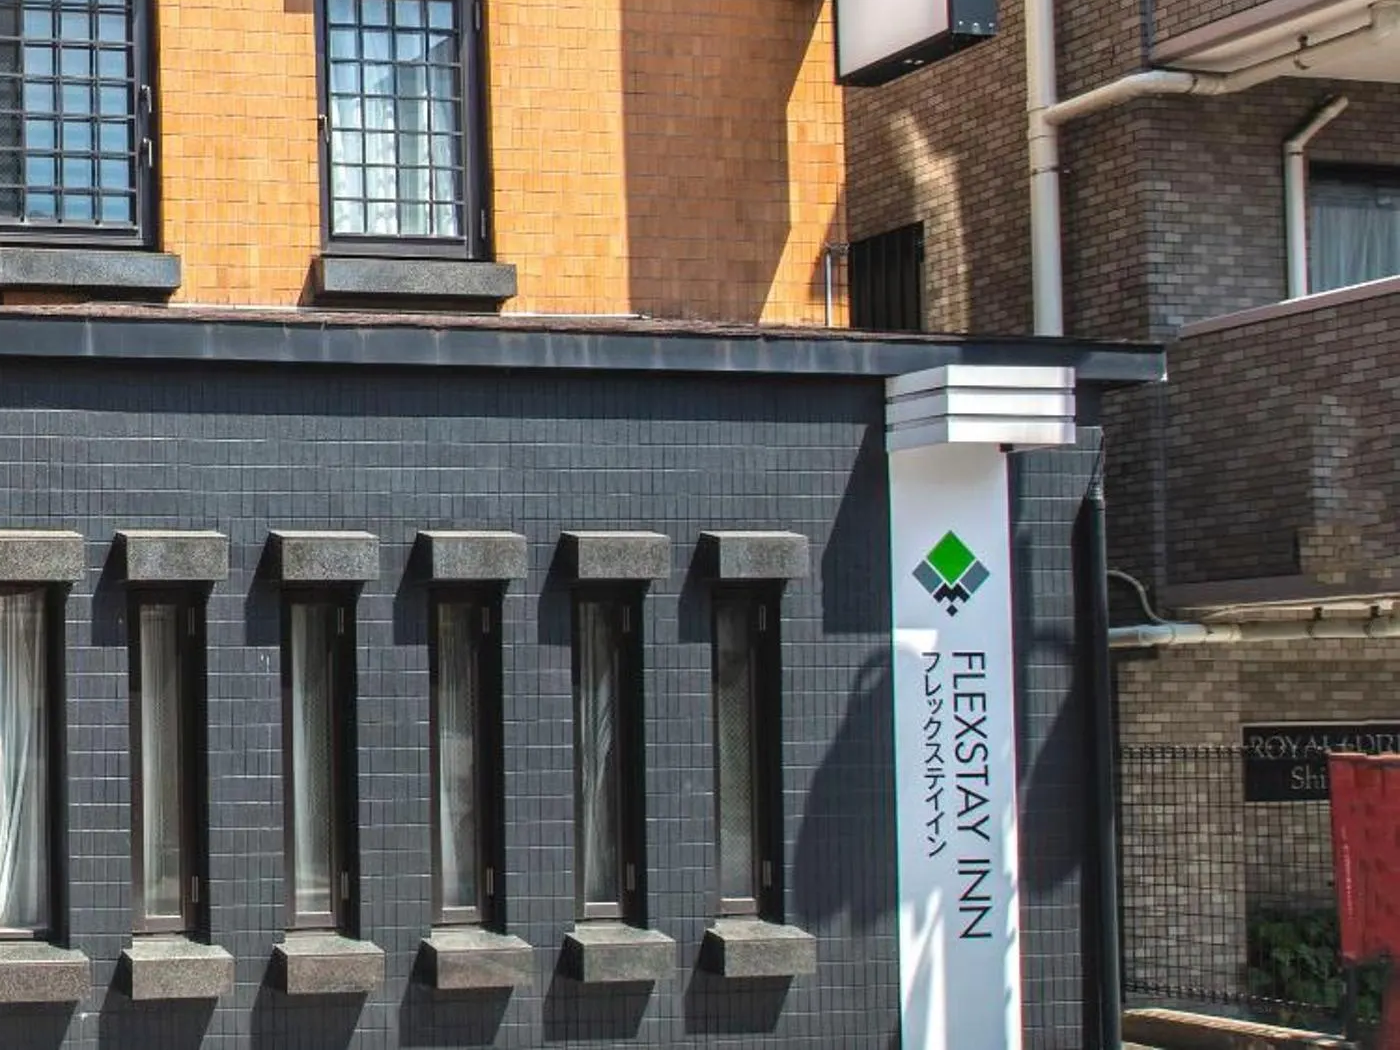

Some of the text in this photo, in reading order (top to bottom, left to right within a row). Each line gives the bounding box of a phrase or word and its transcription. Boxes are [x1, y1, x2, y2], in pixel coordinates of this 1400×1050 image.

[921, 652, 947, 858] フレックステイイン
[952, 652, 993, 940] FLEXSTAY INN
[1250, 734, 1333, 760] ROYAL
